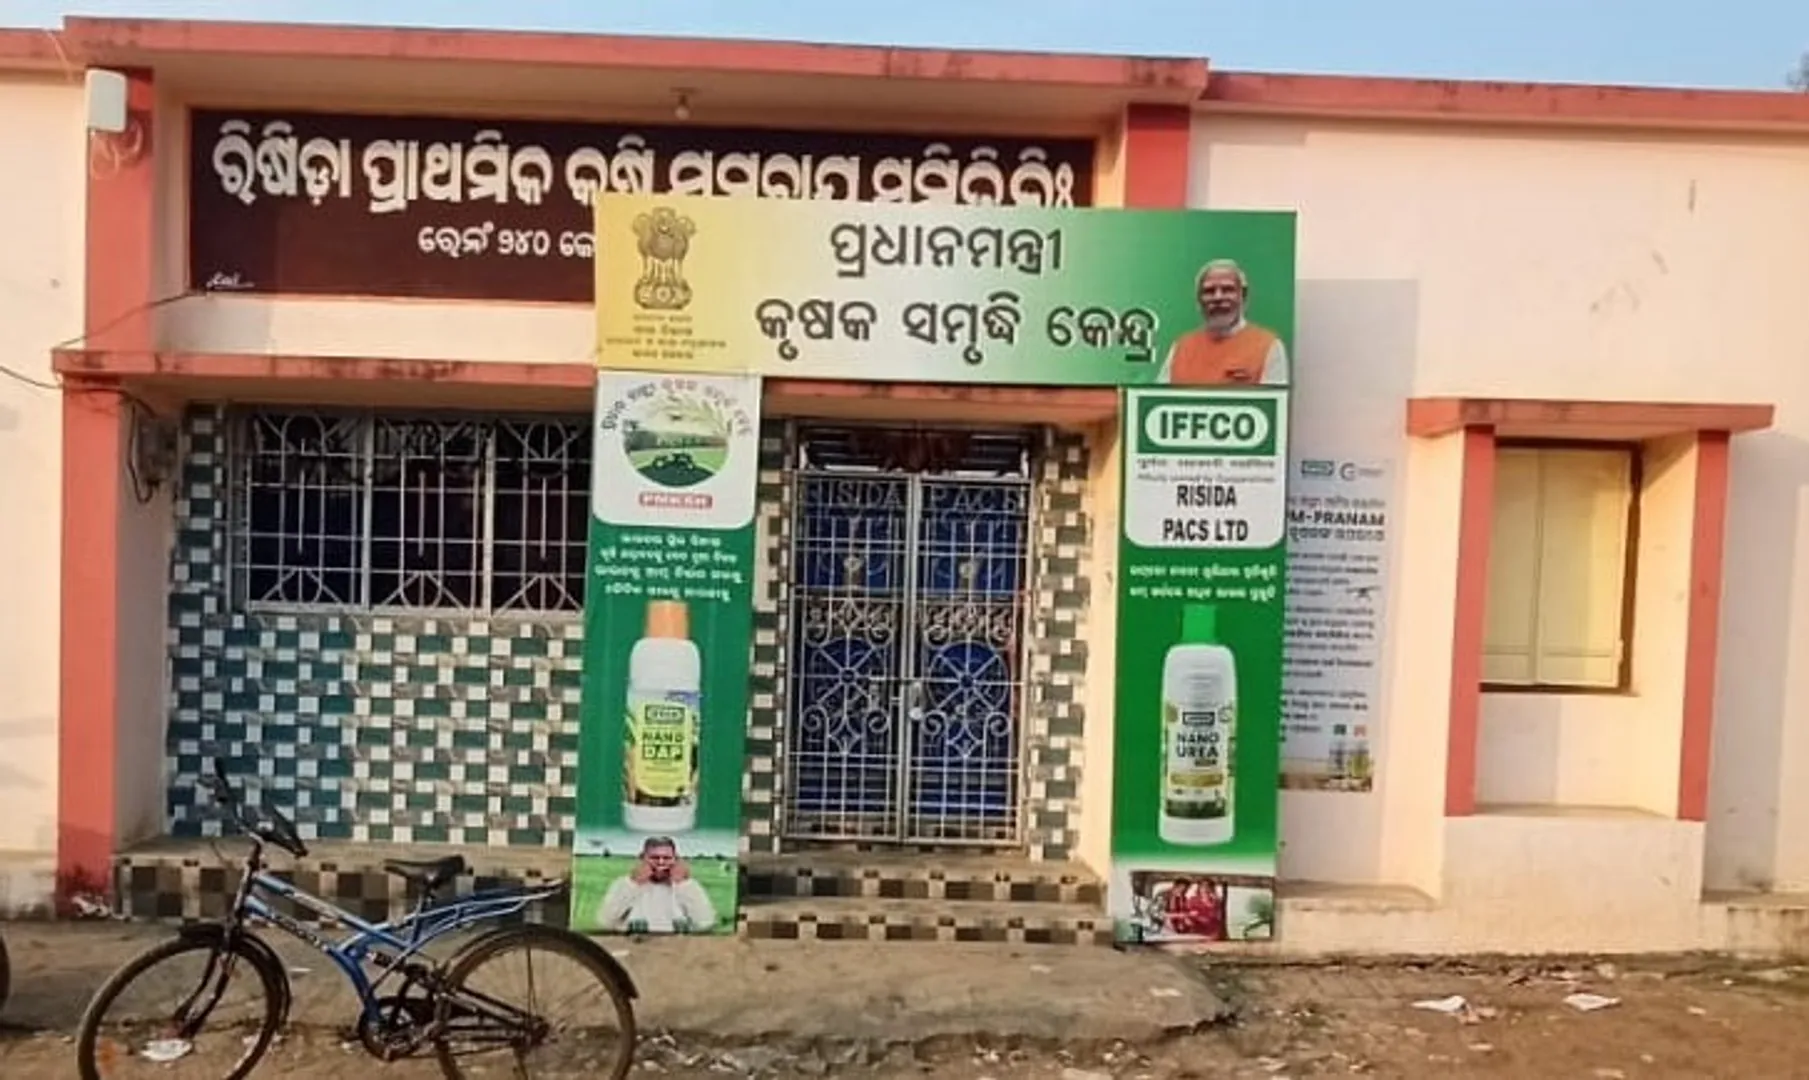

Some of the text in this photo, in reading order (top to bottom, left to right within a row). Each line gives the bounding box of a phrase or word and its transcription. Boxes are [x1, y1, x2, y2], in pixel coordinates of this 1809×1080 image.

[362, 129, 554, 213] ପ୍ରାଥମିକ
[565, 133, 654, 207] କଷି
[830, 222, 1063, 278] ପ୍ରଧାନମନ୍ତ୍ରୀ
[755, 297, 877, 361] କୃଷକ
[902, 291, 1022, 365] ସମୃଦ୍ଧି
[1047, 303, 1160, 363] କେନ୍ଦ୍ର
[1159, 411, 1257, 441] IFFCO
[1176, 485, 1238, 507] RISIDA
[1162, 519, 1250, 542] PACS LTD
[642, 730, 686, 743] NANO
[1176, 731, 1221, 744] NANO
[1176, 745, 1219, 759] UREA
